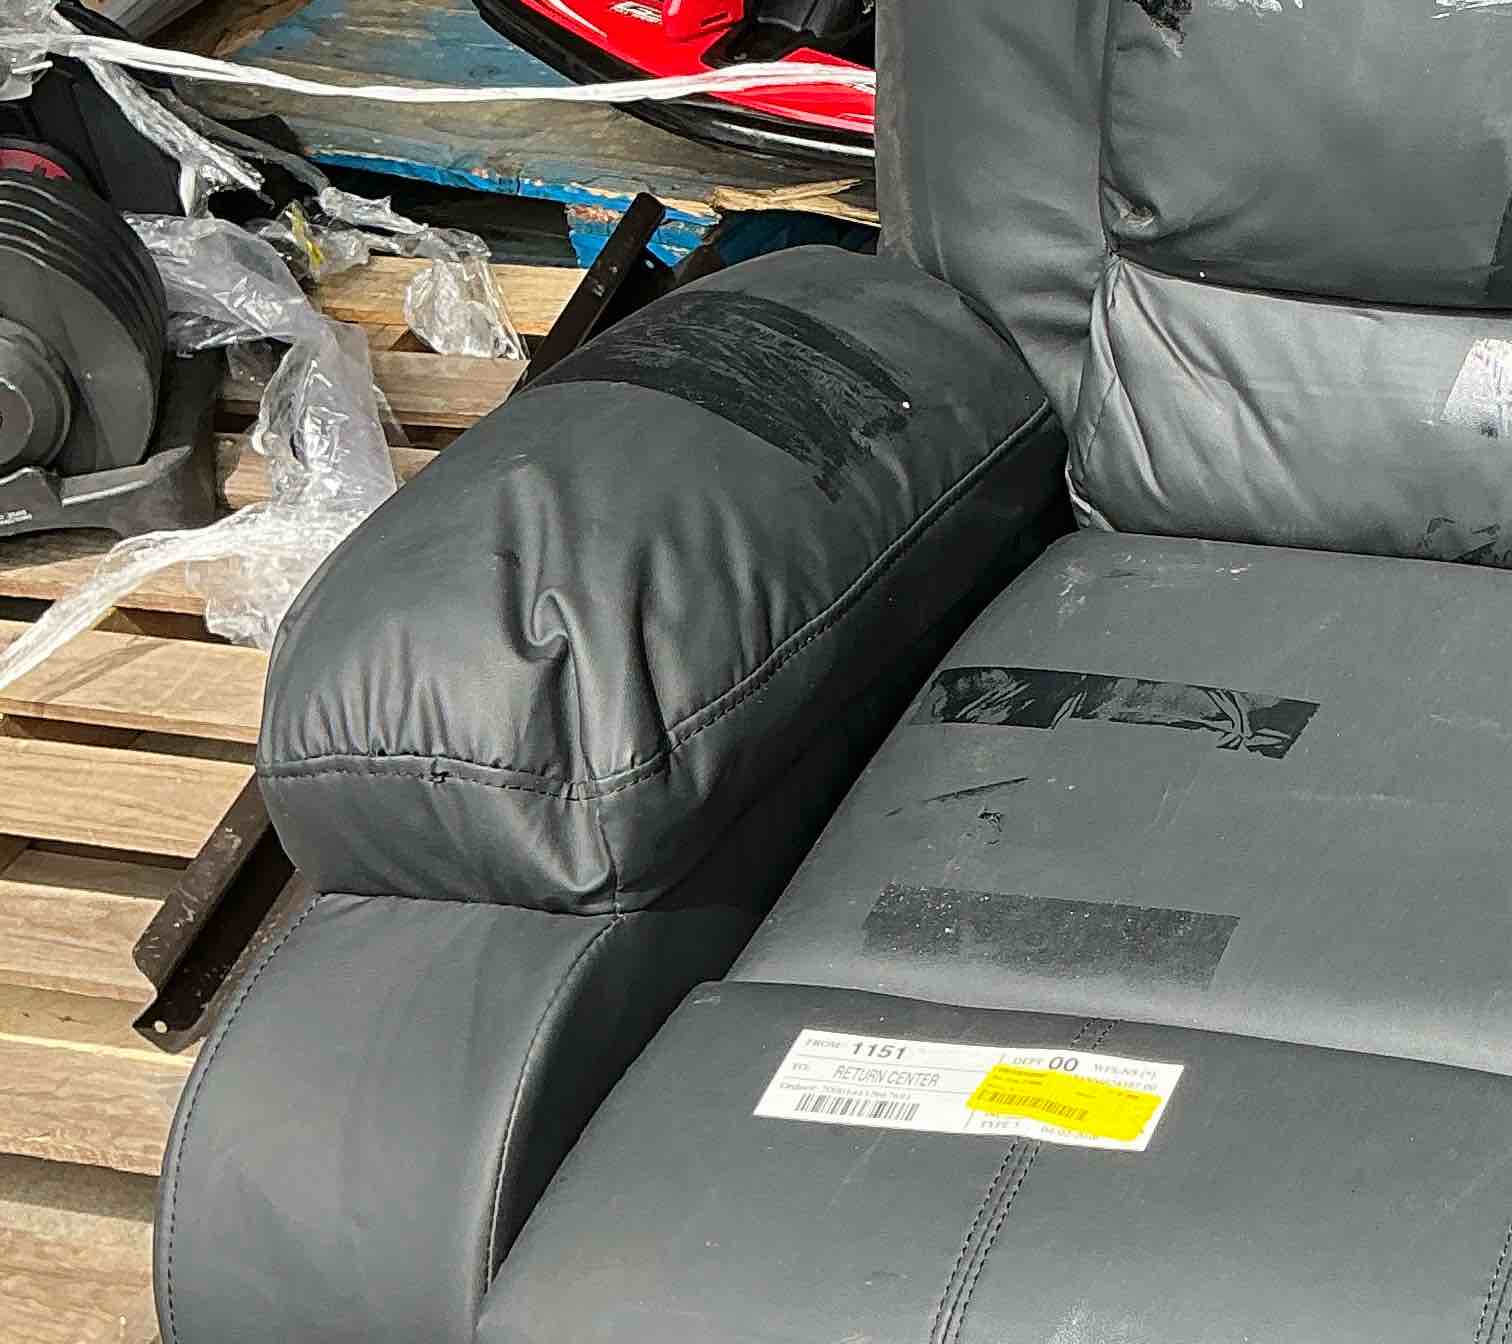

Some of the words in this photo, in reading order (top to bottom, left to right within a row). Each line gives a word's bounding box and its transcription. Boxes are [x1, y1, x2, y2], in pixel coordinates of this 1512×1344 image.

[850, 1040, 908, 1061] 1151
[1047, 1055, 1080, 1072] 00
[831, 1064, 887, 1085] RETURN
[885, 1070, 942, 1088] CENTER
